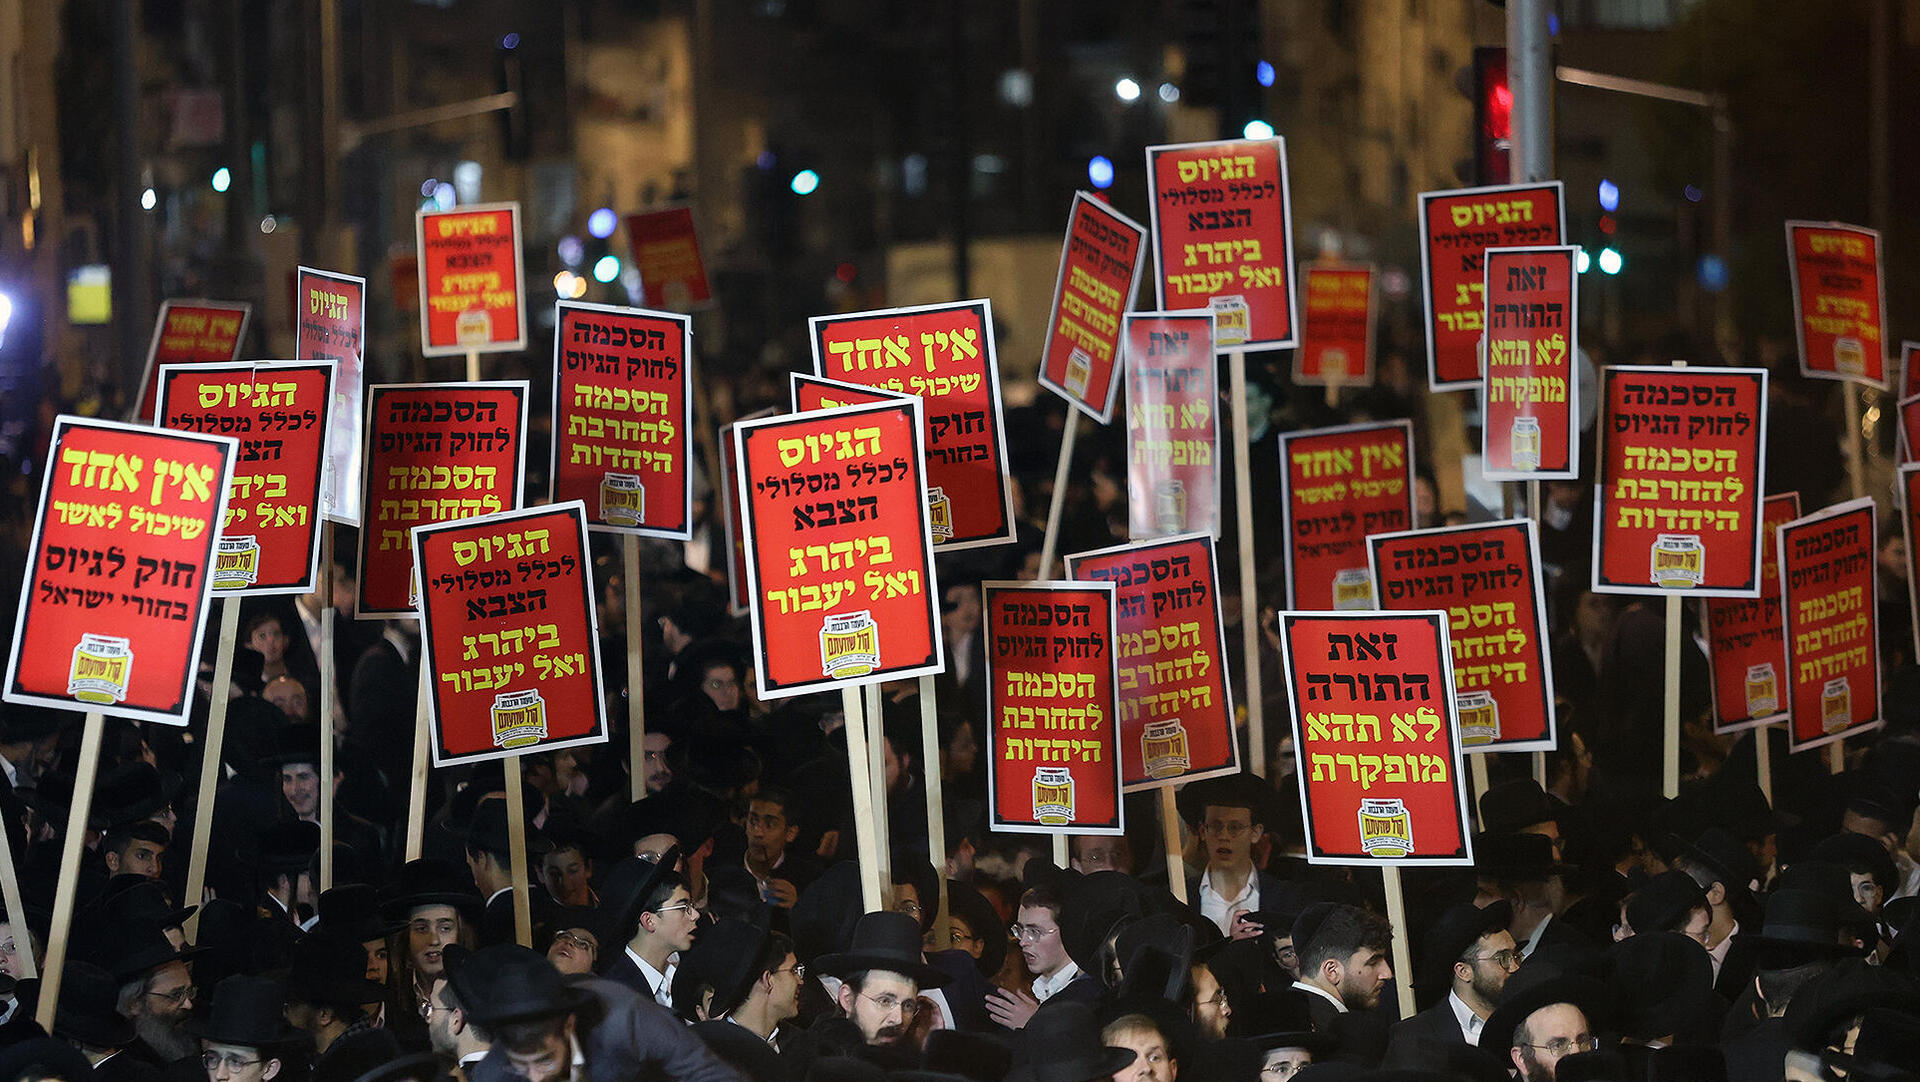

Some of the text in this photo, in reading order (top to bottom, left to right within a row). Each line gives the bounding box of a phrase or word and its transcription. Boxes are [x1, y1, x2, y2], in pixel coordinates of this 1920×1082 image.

[1177, 155, 1255, 183] הגיוס
[1187, 208, 1251, 231] הצבא
[1451, 200, 1532, 226] הגיוס
[1184, 239, 1261, 266] ביהרג
[1167, 265, 1280, 293] ואל יעבור
[1506, 263, 1546, 292] זאת
[1438, 309, 1485, 330] בור
[1493, 301, 1562, 329] התורה
[572, 319, 665, 351] הסכמה
[828, 327, 978, 373] אין אחד
[1490, 332, 1565, 365] לא תהא
[565, 348, 678, 381] לחוק הגיוס
[198, 381, 297, 408] הגיוס
[575, 382, 669, 415] הסכמה
[908, 372, 981, 397] שיכול
[1490, 374, 1564, 407] מופקרת
[1624, 380, 1736, 407] הסכמה
[171, 410, 316, 433] לכלל מסלולי
[389, 400, 498, 423] הסכמה
[1614, 411, 1750, 440] לחוק הגיוס
[379, 426, 510, 457] לחוק הגיוס
[568, 414, 676, 444] להחרבת
[929, 410, 984, 444] חוק
[235, 439, 282, 461] הצ
[571, 442, 673, 472] היהדות
[777, 426, 881, 467] הגיוס
[1293, 444, 1402, 478] אין אחד
[1625, 445, 1738, 472] הסכמה
[62, 447, 214, 505] אין אחד
[229, 473, 287, 499] ביה
[388, 464, 497, 490] הסכמה
[756, 457, 908, 499] לכלל מסלולי
[1616, 476, 1744, 501] להחרבת
[53, 500, 122, 528] לאשר
[255, 502, 307, 527] ואל
[379, 493, 503, 520] להחרבת
[792, 495, 878, 530] הצבא
[1618, 506, 1740, 529] היהדות
[128, 505, 205, 539] שיכול
[451, 529, 550, 566] הגיוס
[789, 535, 892, 576] ביהרג
[1393, 540, 1505, 570] הסכמה
[1794, 525, 1858, 558] הסכמה
[45, 544, 196, 588] חוק לגיוס
[431, 555, 575, 593] לכלל מסלולי
[1460, 563, 1523, 597] לחוק
[40, 579, 188, 621] בחורי ישראל
[767, 569, 919, 614] ואל יעבור
[1151, 580, 1206, 618] לחוק
[1388, 574, 1453, 599] הגיוס
[465, 589, 546, 620] הצבא
[1002, 602, 1090, 626] הסכמה
[1450, 602, 1516, 630] הסכ
[1799, 586, 1863, 624] הסכמה
[462, 624, 560, 660] ביהרג
[996, 631, 1103, 663] לחוק הגיוס
[1327, 631, 1397, 660] זאת
[1449, 628, 1527, 659] להחר
[1797, 612, 1868, 656] להחרבת
[441, 652, 585, 693] ואל יעבור
[1118, 649, 1211, 689] להחרב
[1452, 661, 1528, 688] היהד
[1800, 644, 1867, 685] היהדות
[1007, 671, 1095, 698] הסכמה
[1306, 672, 1430, 701] התורה
[1002, 702, 1102, 730] להחרבת
[1305, 711, 1381, 742] תהא
[1390, 706, 1440, 742] לא
[1005, 736, 1101, 761] היהדות
[1311, 752, 1446, 790] מופקרת
